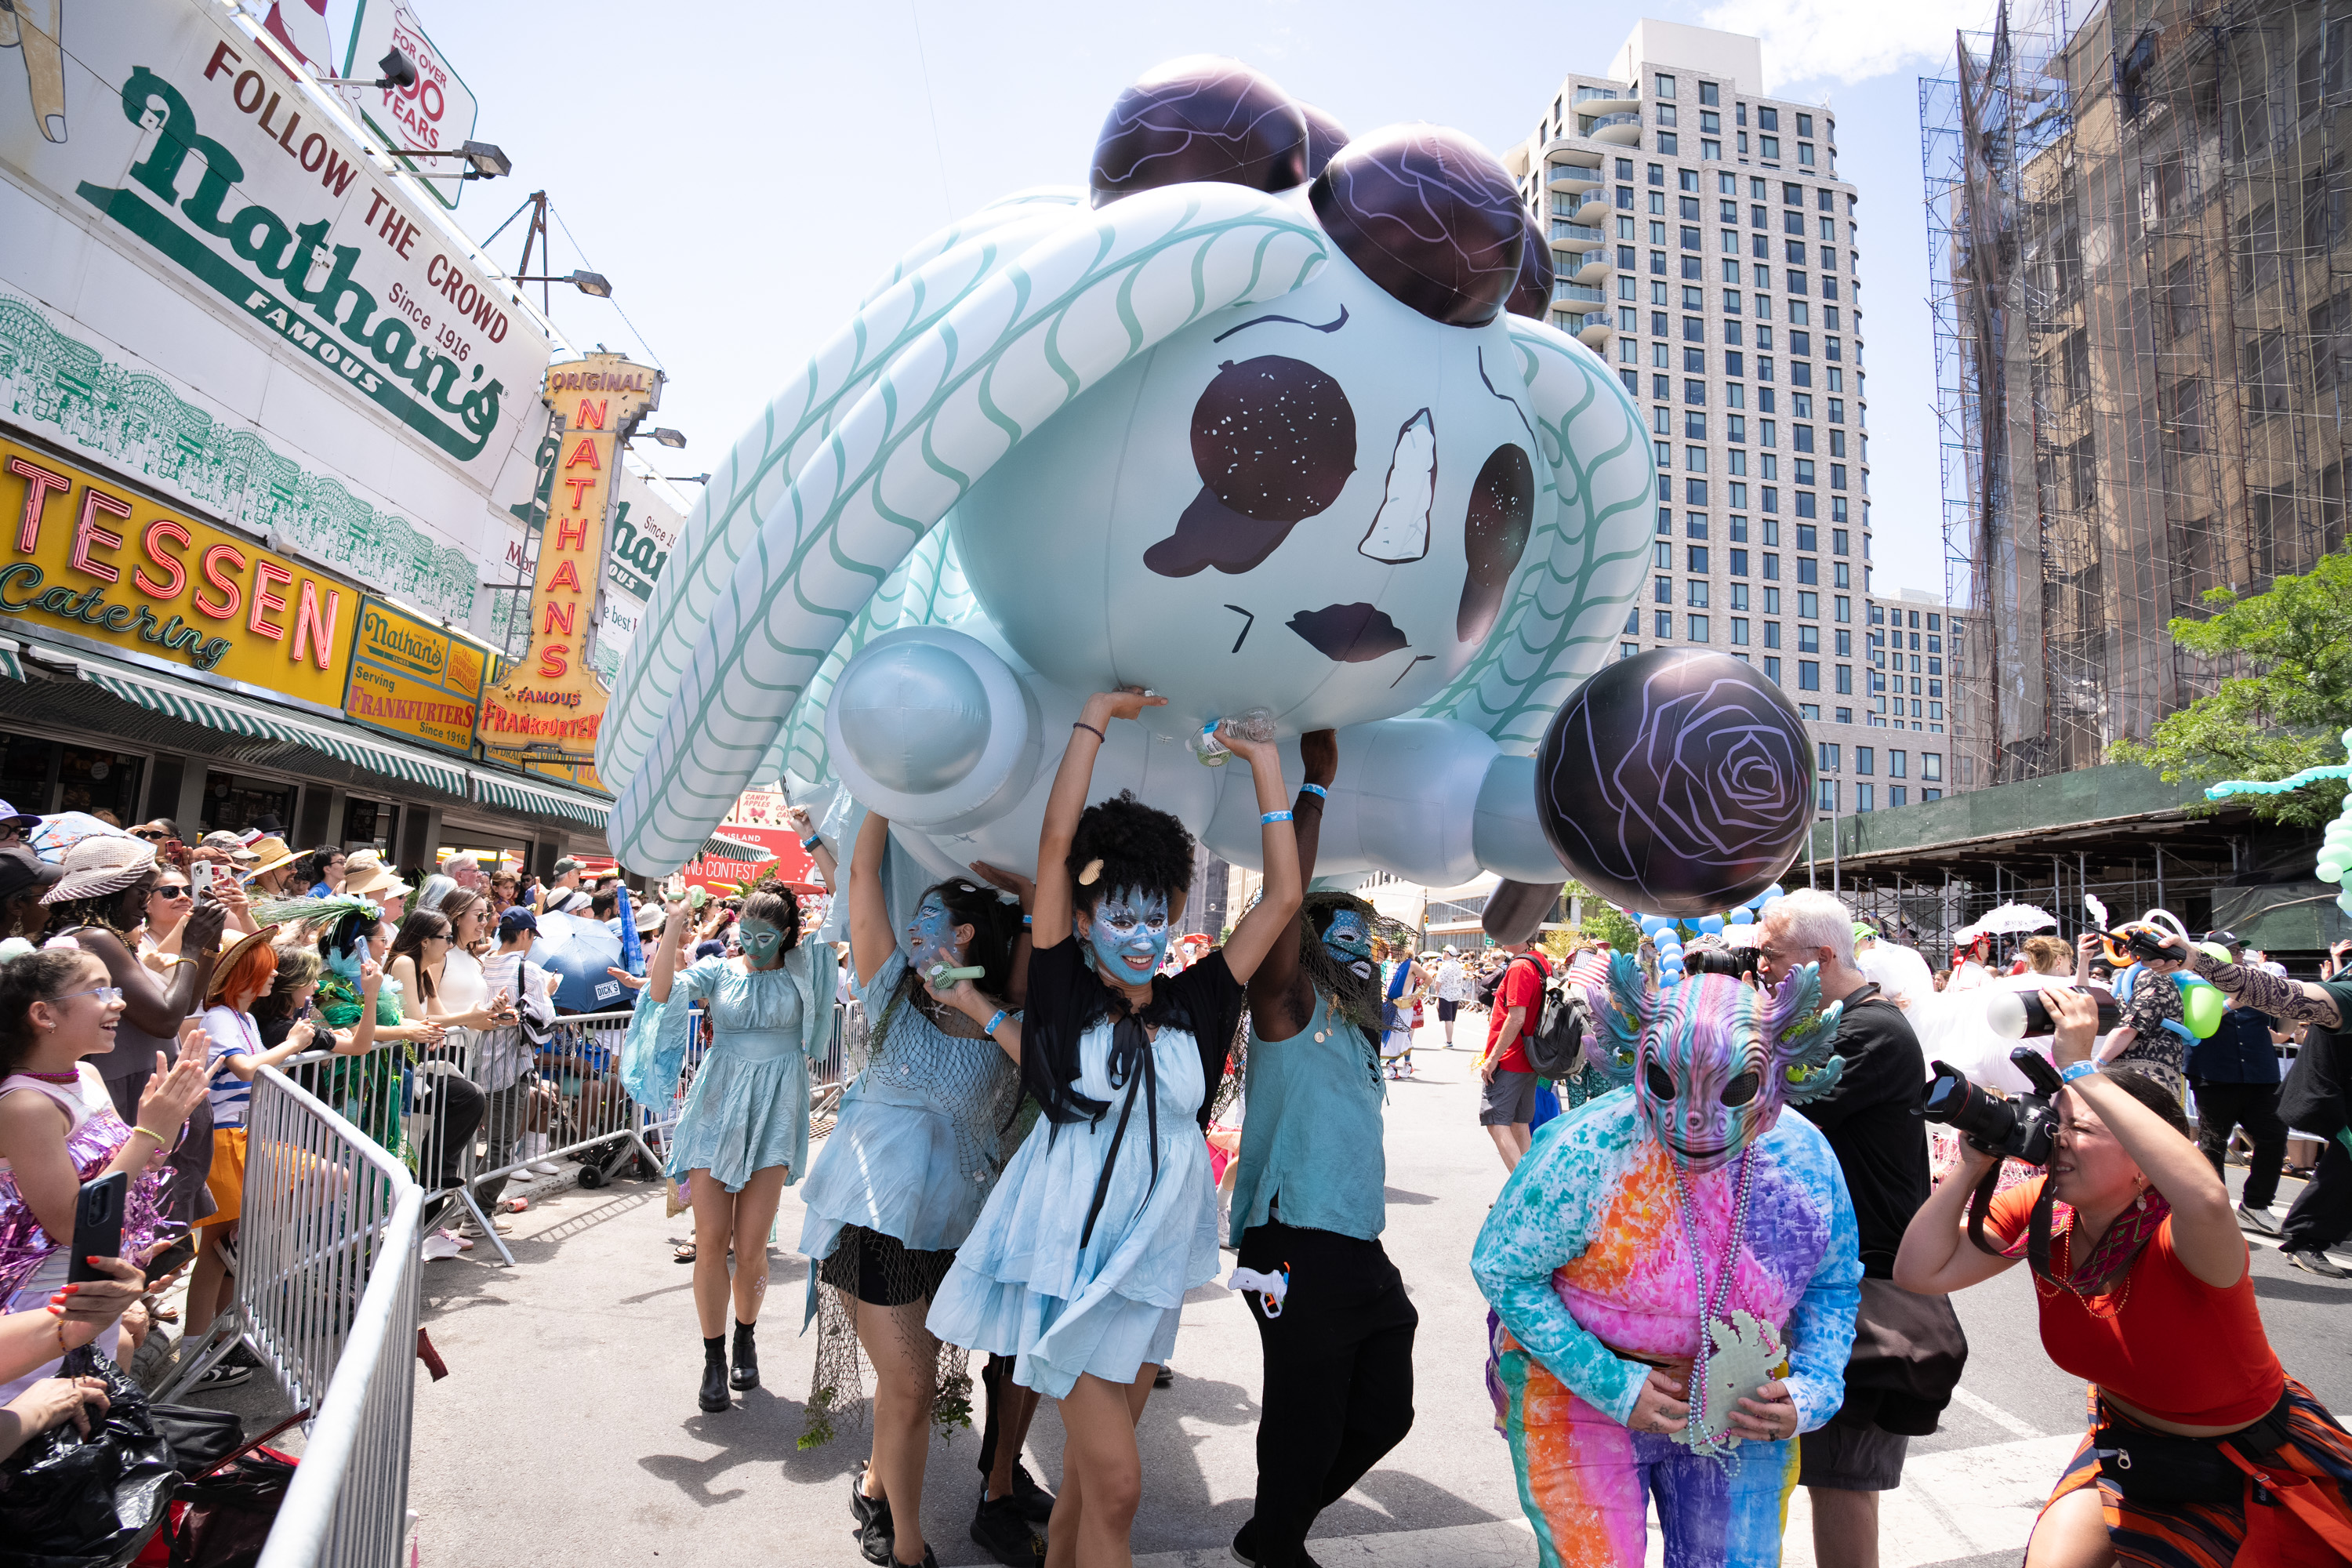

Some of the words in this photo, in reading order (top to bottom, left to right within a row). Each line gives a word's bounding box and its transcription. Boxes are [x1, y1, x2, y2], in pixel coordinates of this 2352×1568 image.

[393, 27, 416, 60] FOR
[419, 54, 447, 89] OVER
[382, 87, 439, 149] YEARS
[203, 39, 358, 198] FOLLOW
[363, 188, 421, 261] THE
[426, 253, 509, 344] CROWD
[388, 281, 432, 330] Since
[435, 322, 471, 362] 1916
[244, 289, 383, 394] FAMOUS
[551, 370, 647, 394] ORIGINAL
[537, 397, 608, 677] NATHANS
[644, 515, 666, 541] Since
[5, 454, 340, 670] TESSEN
[0, 562, 232, 671] Catering
[612, 605, 631, 632] best
[452, 654, 477, 678] FASHIONED
[463, 648, 472, 663] OLD
[355, 666, 395, 693] Serving
[448, 663, 477, 691] LEMONADE
[347, 684, 474, 728] FRANKFURTERS
[517, 689, 582, 706] FAMOUS
[481, 697, 605, 739] FRANKFURTER
[419, 721, 444, 739] Since
[446, 730, 468, 746] 1916.
[727, 833, 761, 842] ISLAND
[706, 861, 758, 880] CONTEST
